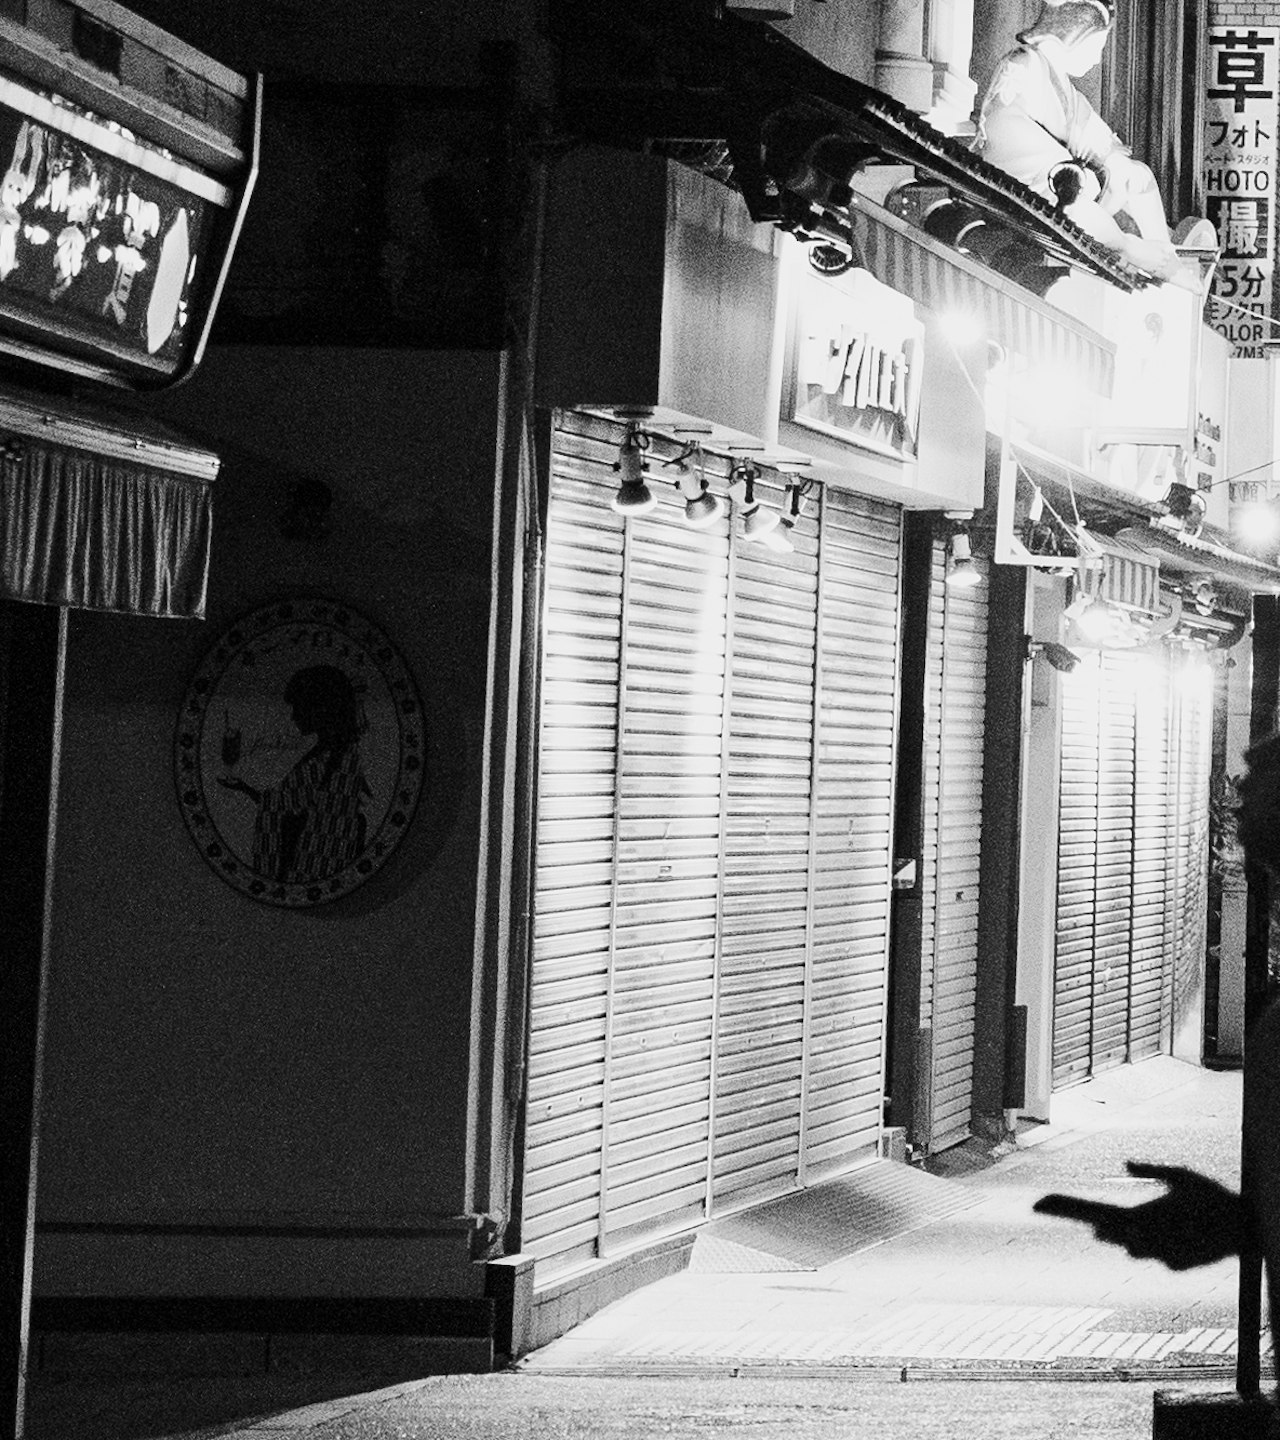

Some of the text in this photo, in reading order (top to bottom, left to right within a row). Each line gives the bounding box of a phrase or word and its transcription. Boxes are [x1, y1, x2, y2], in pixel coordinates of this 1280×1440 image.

[1208, 120, 1271, 148] フォト
[1202, 169, 1270, 192] HOTO
[1215, 200, 1260, 256] 撮
[1208, 323, 1264, 342] OLOR
